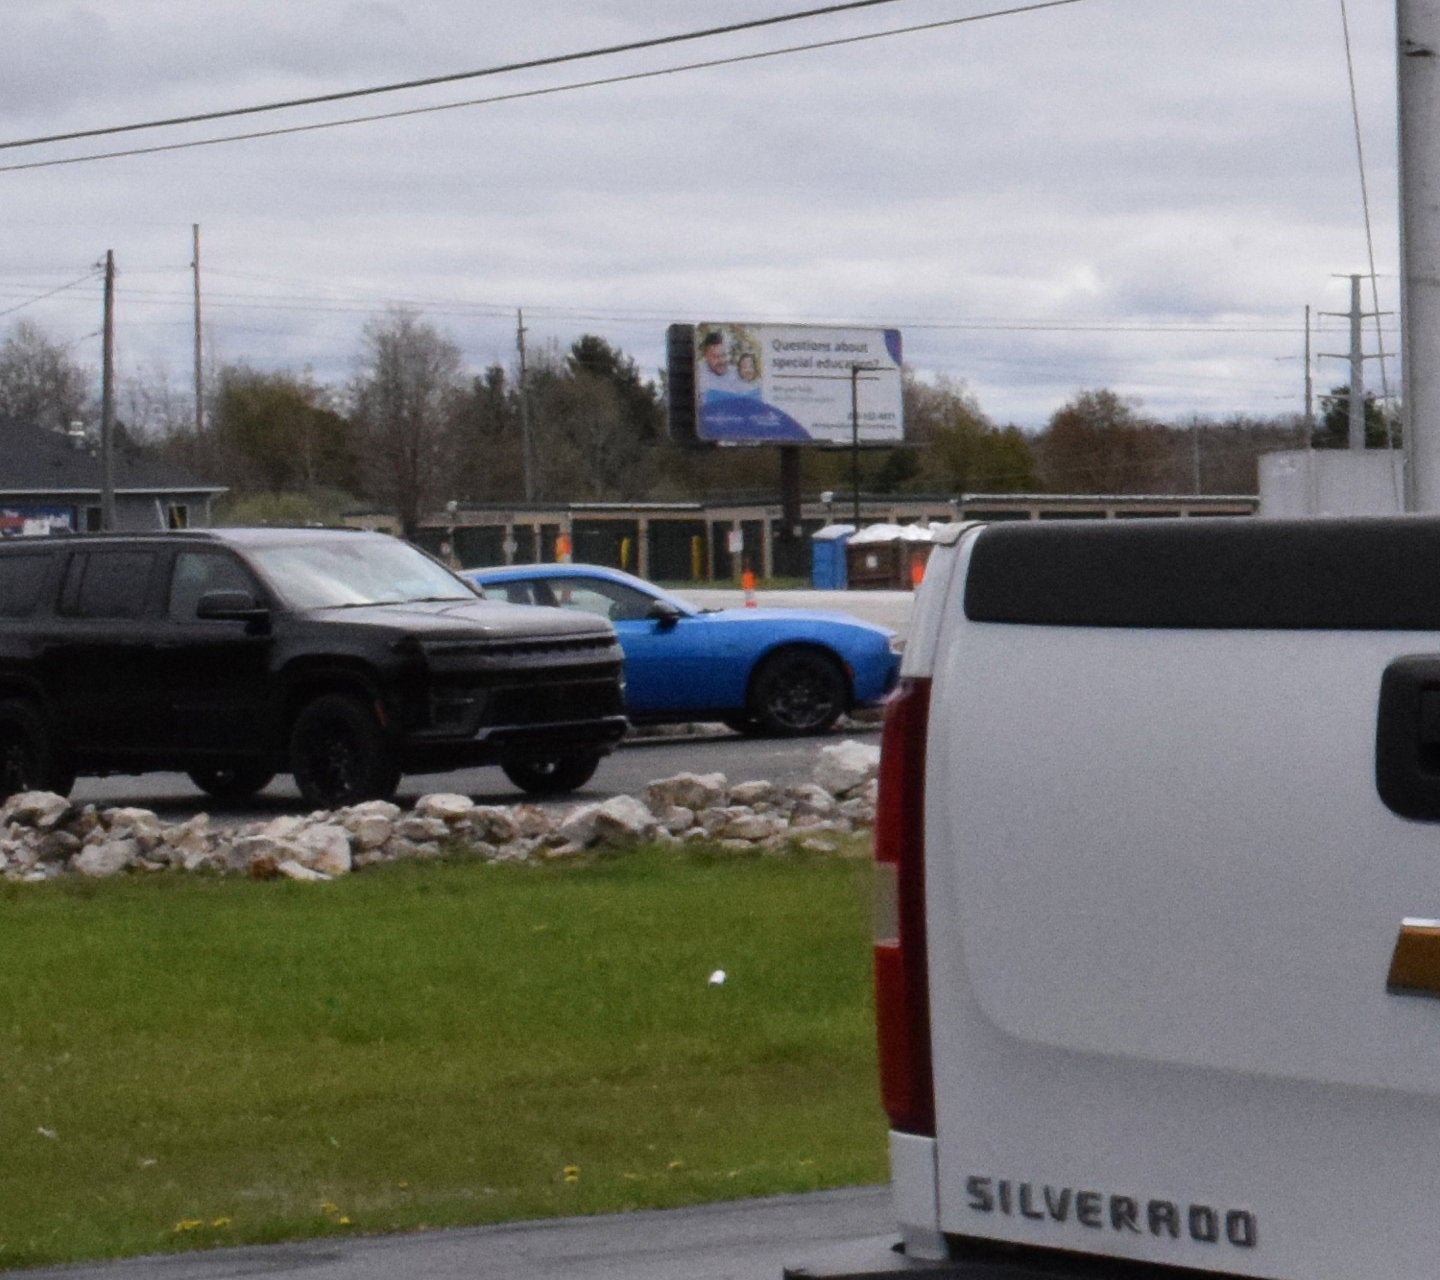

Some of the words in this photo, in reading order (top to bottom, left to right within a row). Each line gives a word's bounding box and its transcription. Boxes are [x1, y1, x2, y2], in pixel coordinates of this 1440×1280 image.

[771, 338, 831, 354] Questions
[834, 339, 868, 354] about
[965, 1174, 1258, 1250] SILVERADO
